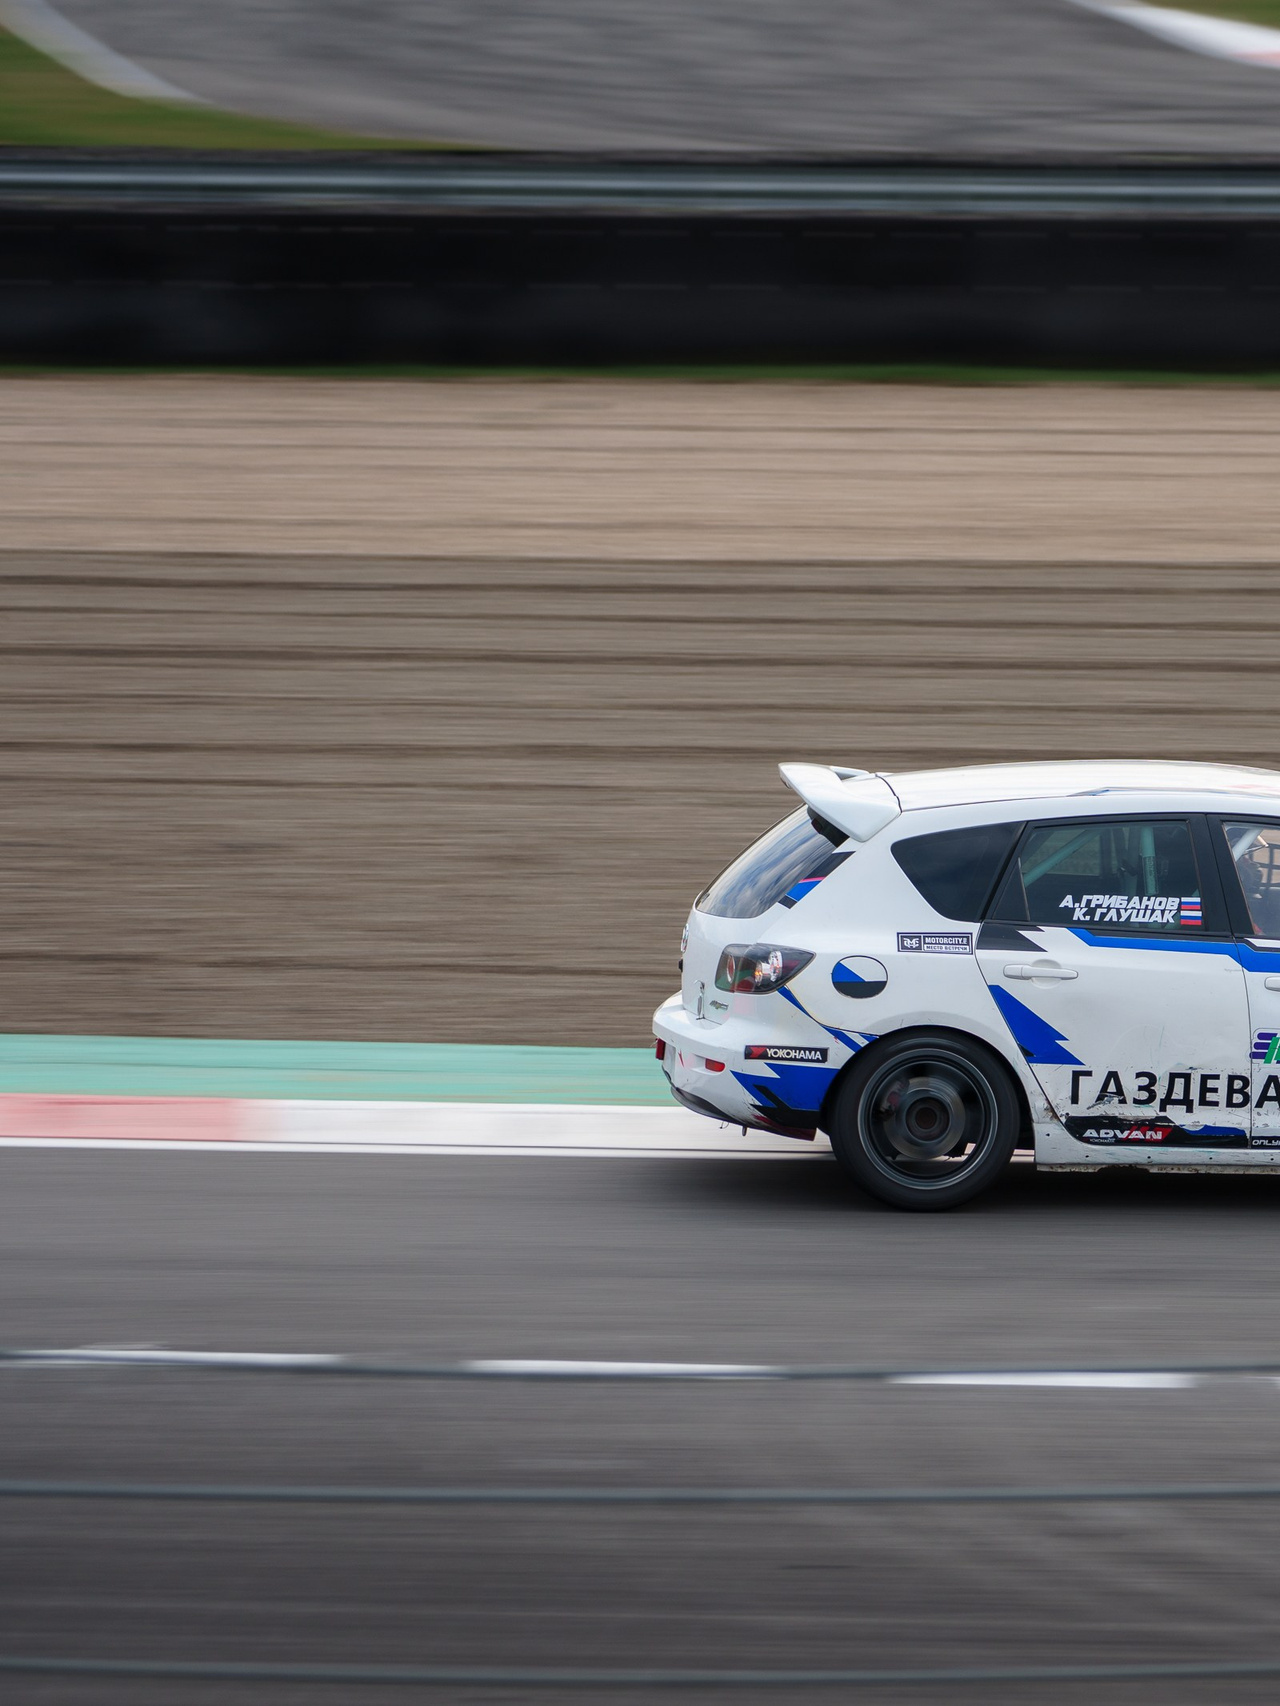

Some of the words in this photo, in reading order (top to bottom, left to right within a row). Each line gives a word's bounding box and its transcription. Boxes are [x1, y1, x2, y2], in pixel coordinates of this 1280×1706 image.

[1093, 908, 1178, 923] ГЛУШАК
[766, 1048, 822, 1060] YOKOHAMA
[1082, 1129, 1162, 1139] ADVAN
